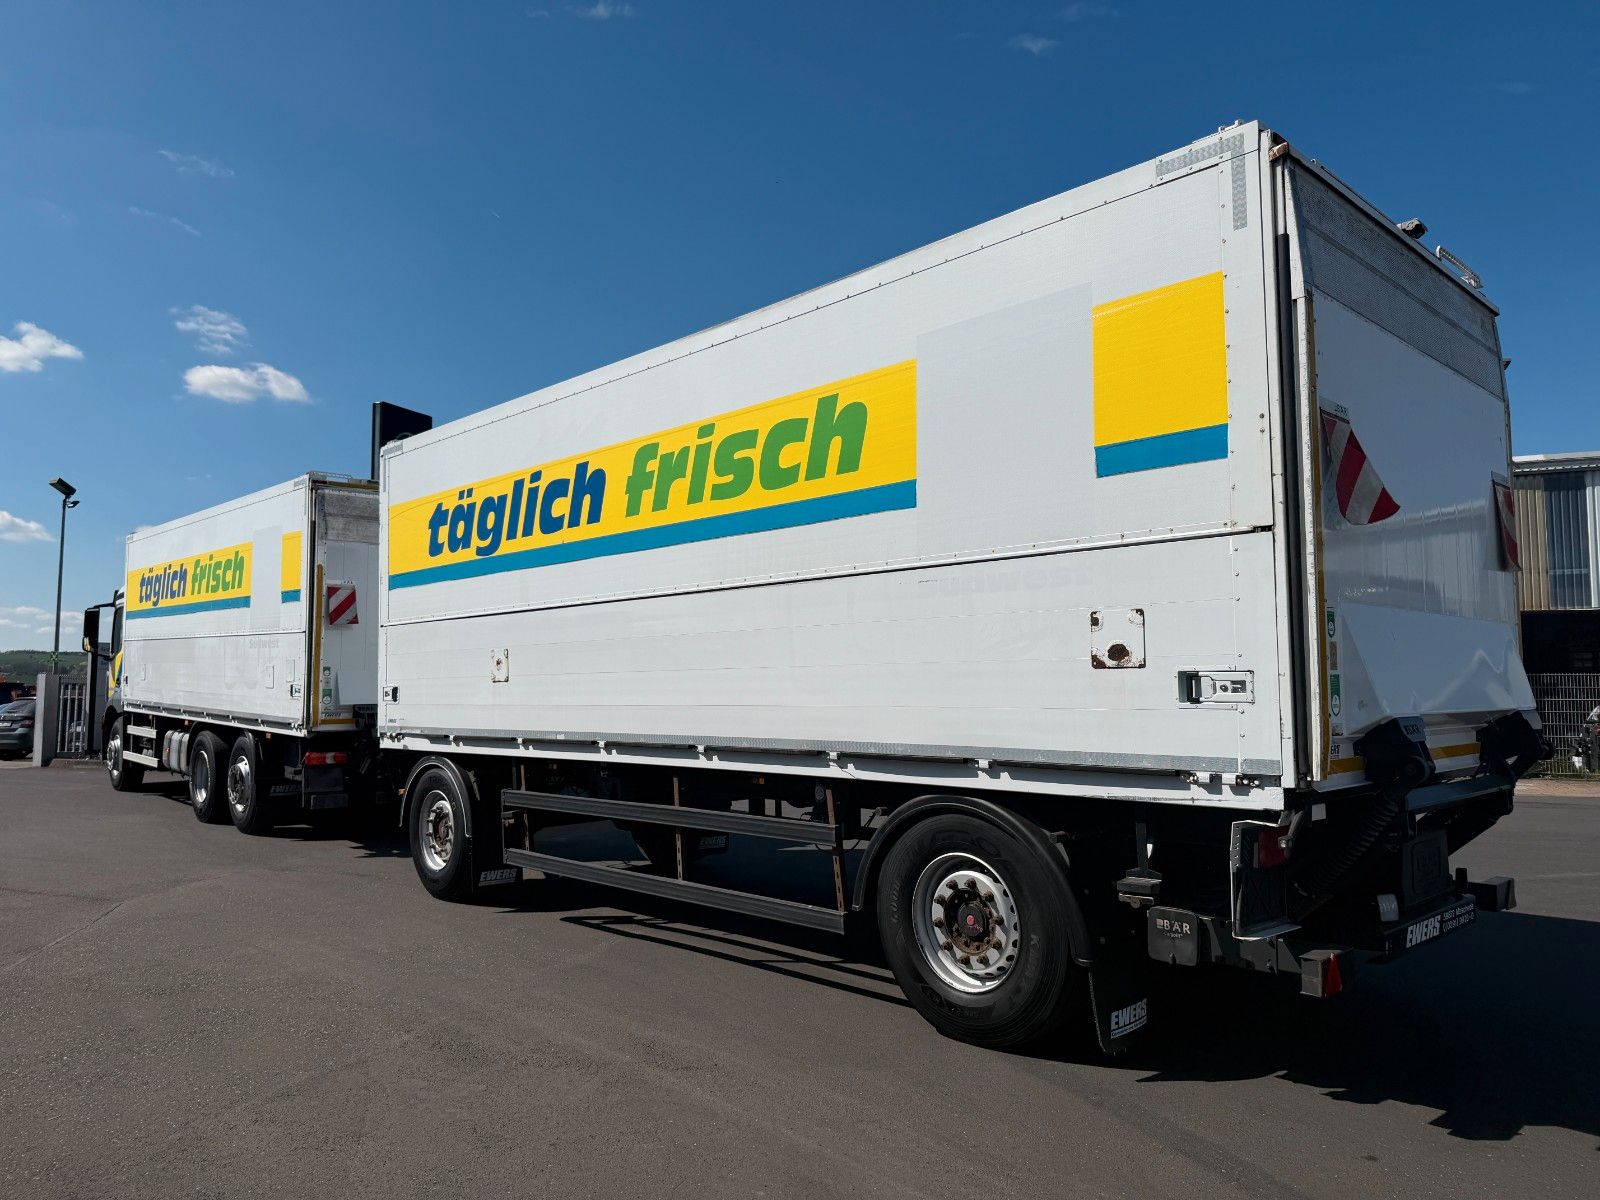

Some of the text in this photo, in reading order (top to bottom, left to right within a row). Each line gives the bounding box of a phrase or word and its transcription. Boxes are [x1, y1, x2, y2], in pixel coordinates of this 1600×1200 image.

[427, 392, 869, 557] täglich frisch
[139, 550, 245, 607] täglich frisch
[480, 868, 517, 881] EWERS
[1406, 915, 1441, 948] EWERS
[1110, 997, 1147, 1031] EWERS
